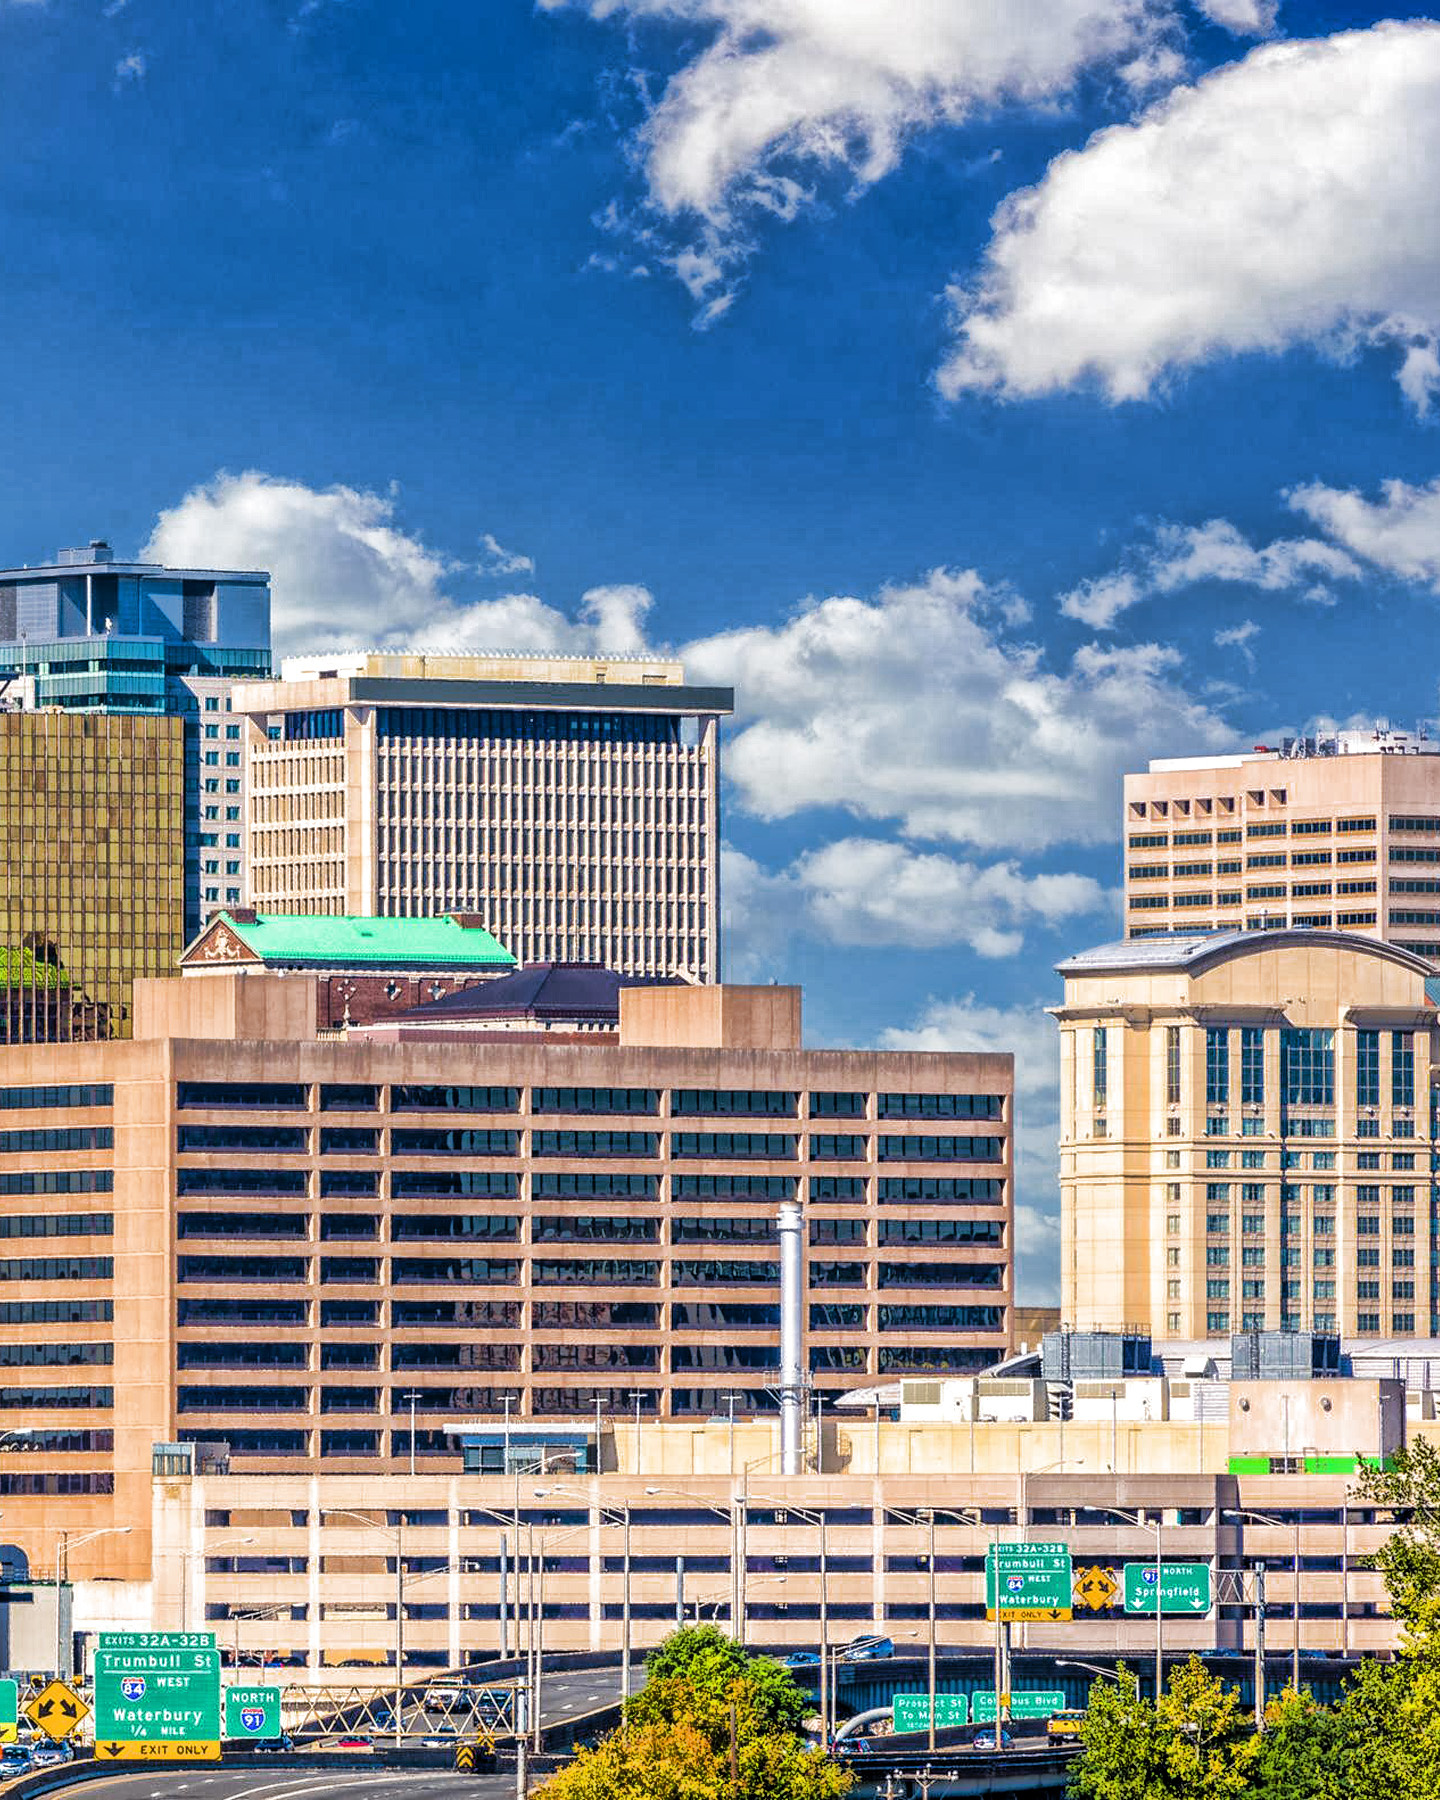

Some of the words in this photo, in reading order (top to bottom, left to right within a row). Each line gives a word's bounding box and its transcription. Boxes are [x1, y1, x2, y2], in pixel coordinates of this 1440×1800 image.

[1052, 1559, 1065, 1568] St
[1144, 1572, 1155, 1581] 91
[1009, 1580, 1022, 1588] 84
[1135, 1587, 1199, 1598] Sprngfield
[999, 1595, 1059, 1607] Waterbury
[105, 1636, 135, 1646] EXITS
[140, 1635, 210, 1647] 32A-32B
[103, 1654, 181, 1667] Trumbull
[194, 1654, 212, 1667] St
[157, 1677, 190, 1687] WEST
[124, 1684, 143, 1695] 84
[232, 1693, 274, 1702] NORTH
[898, 1699, 945, 1709] Prospct
[951, 1699, 962, 1707] St
[113, 1708, 202, 1726] Waterbury
[902, 1711, 913, 1719] To
[919, 1711, 942, 1719] Mn
[948, 1711, 960, 1719] St
[244, 1715, 260, 1726] 91
[161, 1726, 185, 1735] MILE
[140, 1745, 168, 1755] EXIT
[177, 1745, 208, 1755] ONLY
